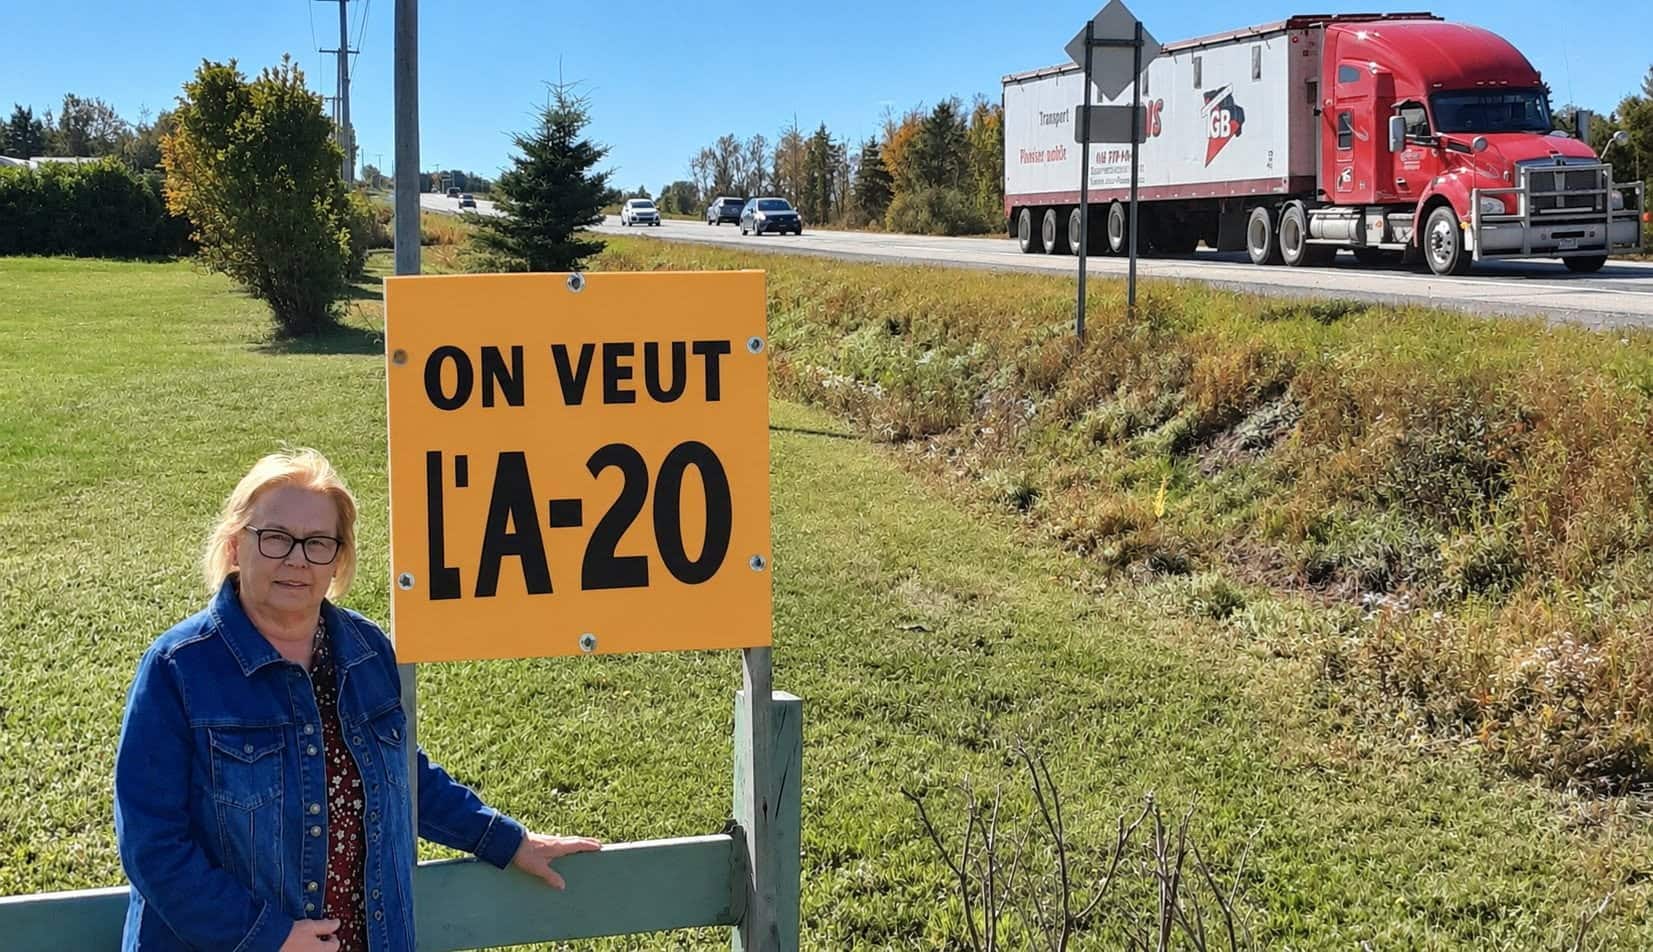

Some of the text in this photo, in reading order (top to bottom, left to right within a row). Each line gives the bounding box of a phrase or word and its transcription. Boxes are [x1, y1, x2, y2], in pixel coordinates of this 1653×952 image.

[1039, 108, 1069, 128] Transport
[424, 340, 731, 411] ON VEUT
[426, 441, 733, 601] L'A-20
